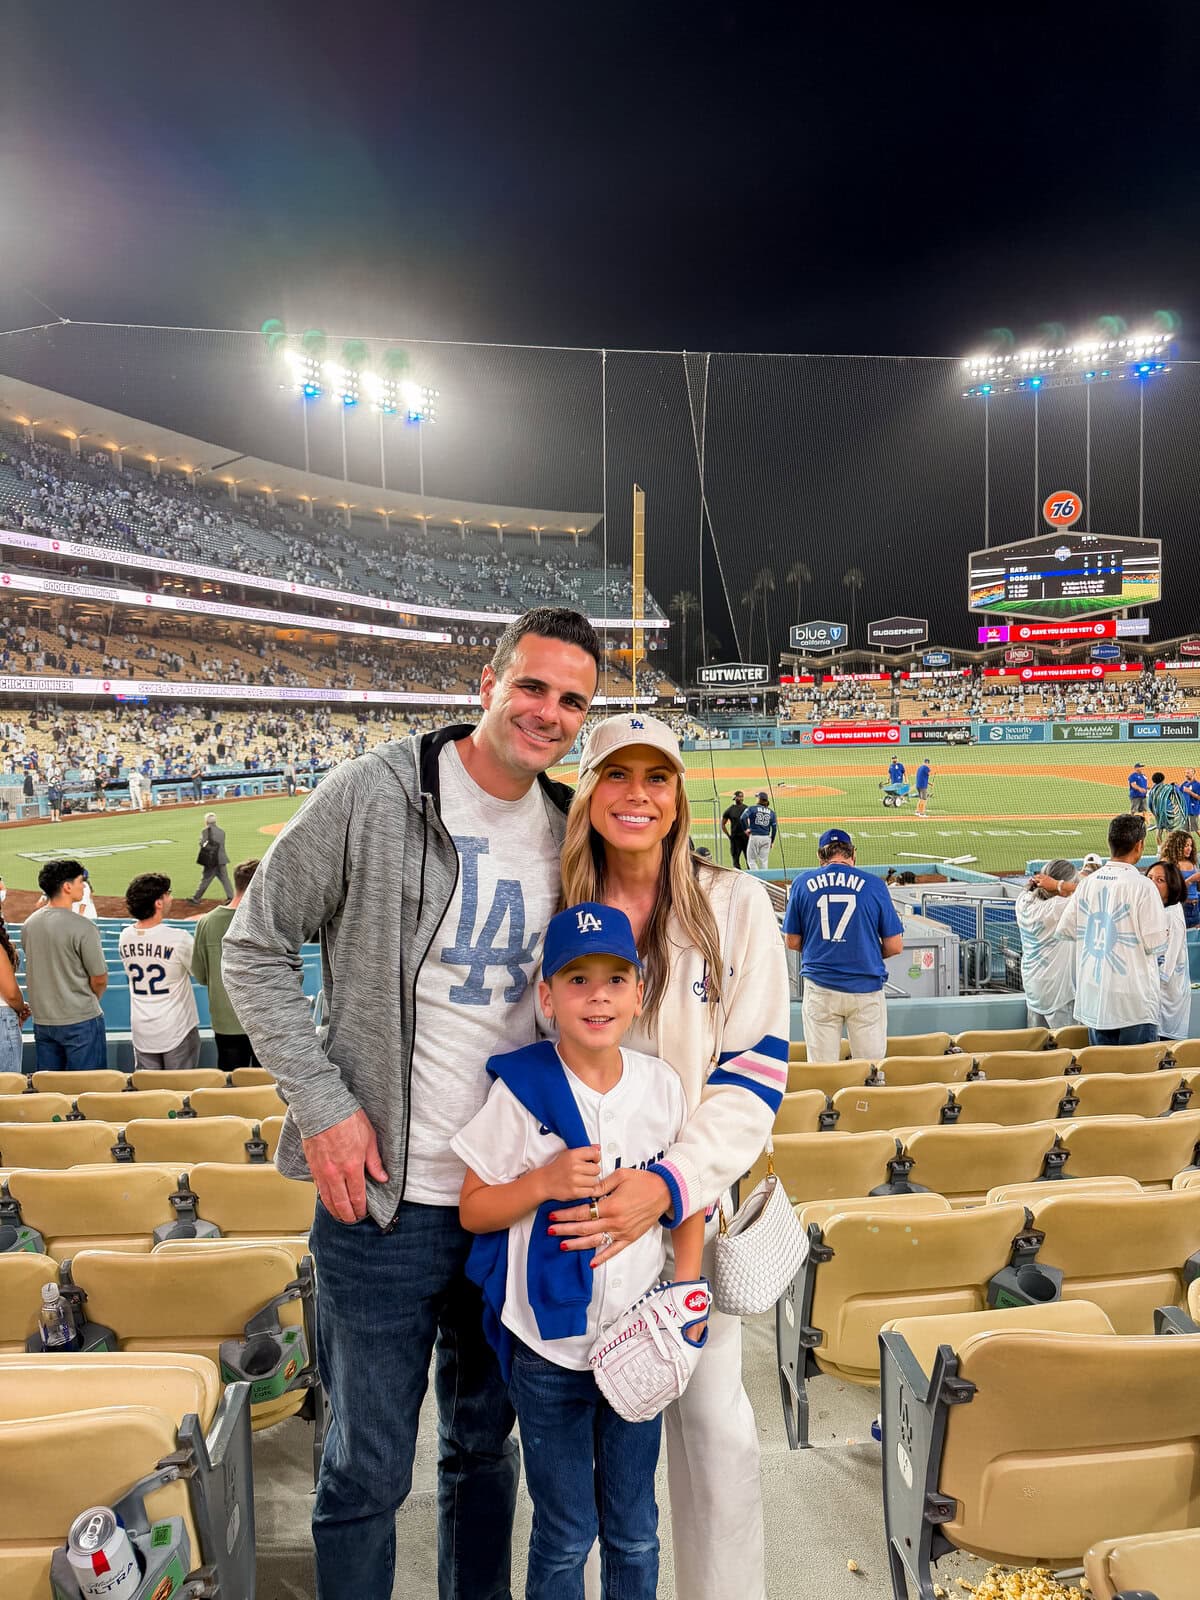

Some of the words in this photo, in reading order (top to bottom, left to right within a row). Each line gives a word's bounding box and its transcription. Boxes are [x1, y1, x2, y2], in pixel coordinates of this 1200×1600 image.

[1051, 499, 1074, 518] 76
[1009, 574, 1042, 582] DODGERS
[796, 628, 827, 640] blue
[873, 628, 923, 637] GUGGENHEIM
[702, 668, 763, 682] CUTWATER
[630, 719, 645, 729] LA
[1005, 726, 1033, 734] Security
[1163, 726, 1193, 735] Health
[806, 872, 866, 893] OHTANI
[440, 835, 542, 1006] LA
[576, 910, 602, 934] LA
[816, 894, 857, 941] 17
[128, 963, 170, 995] 22
